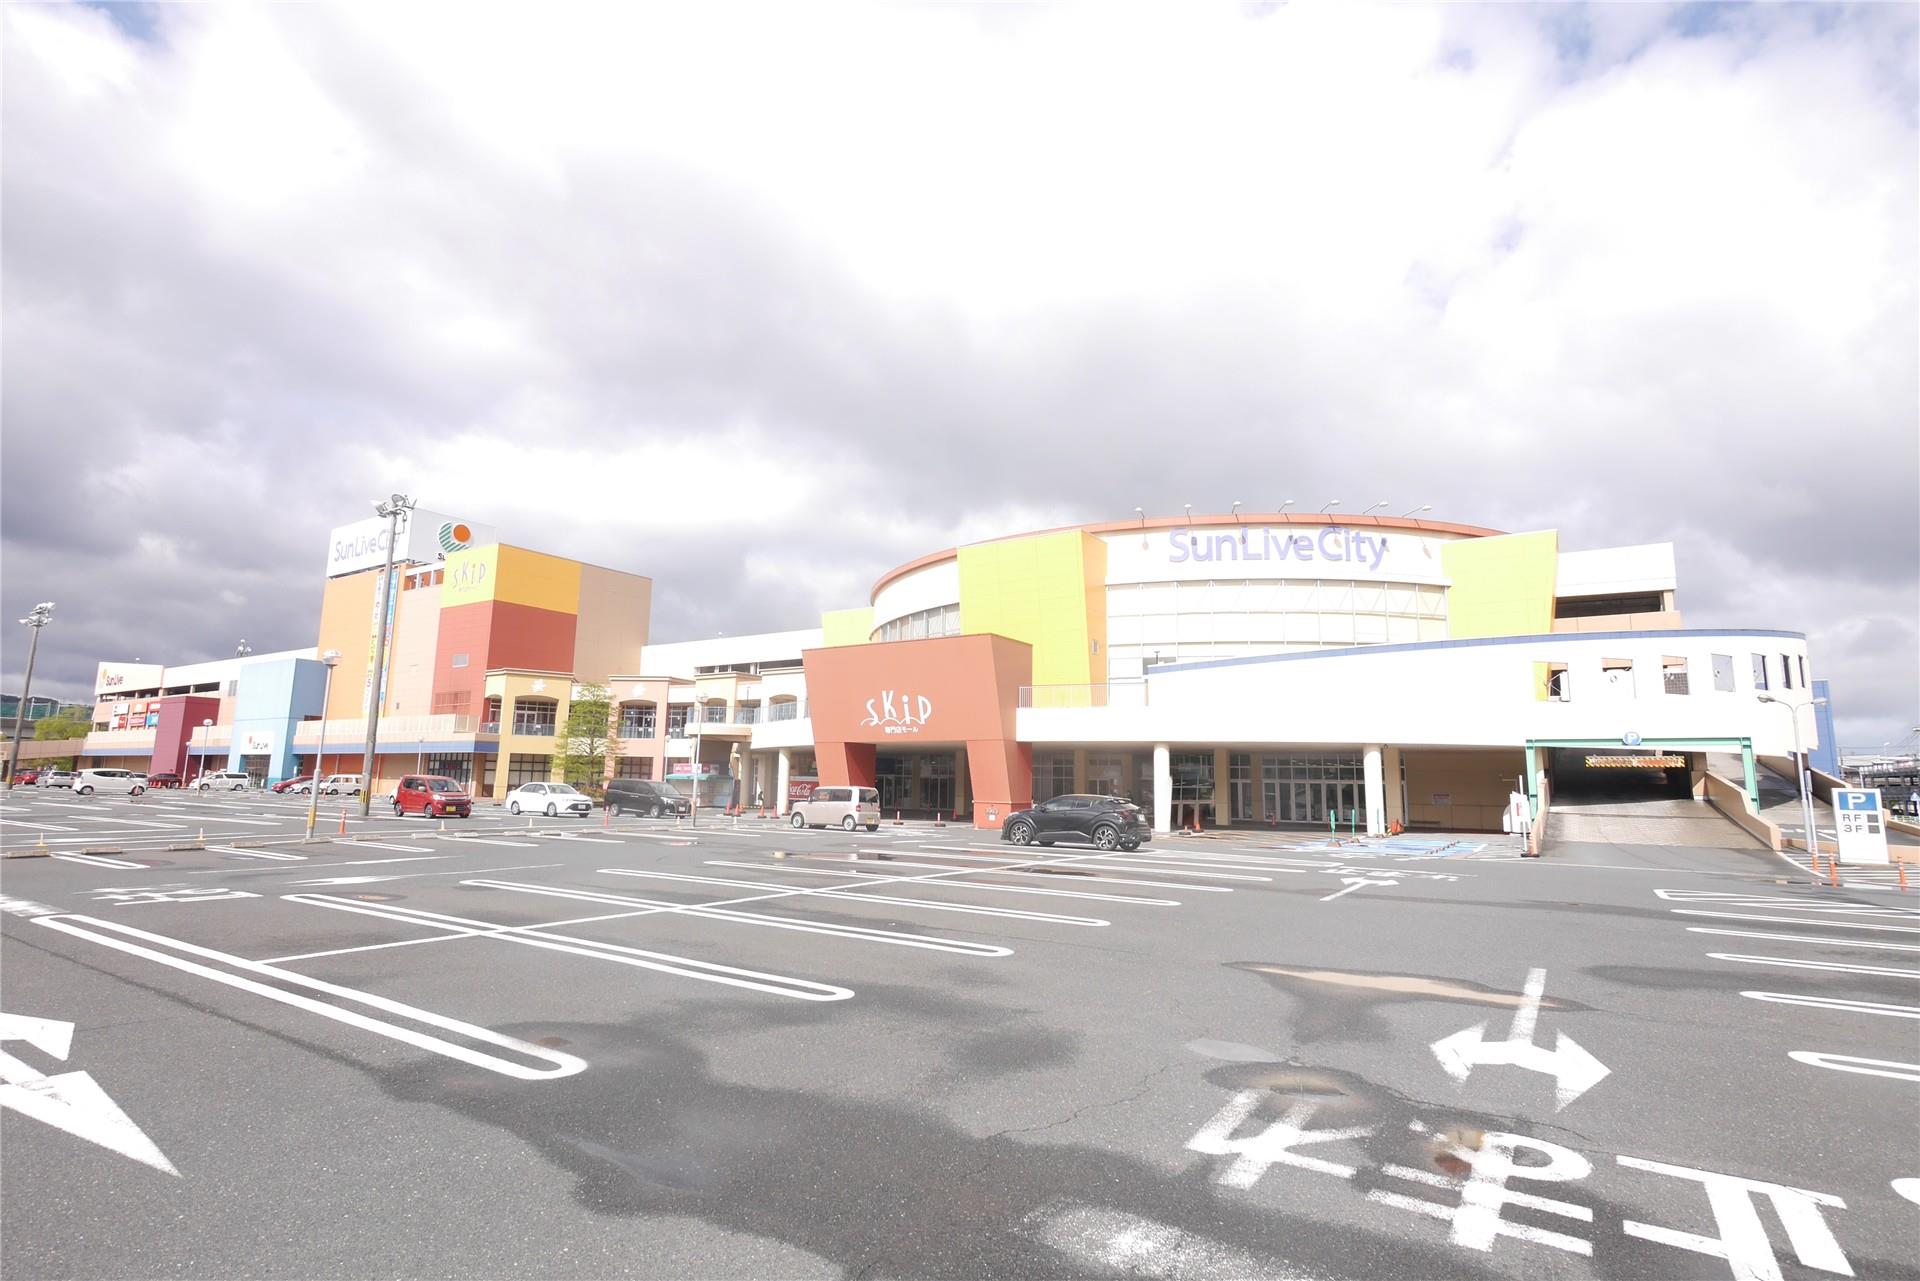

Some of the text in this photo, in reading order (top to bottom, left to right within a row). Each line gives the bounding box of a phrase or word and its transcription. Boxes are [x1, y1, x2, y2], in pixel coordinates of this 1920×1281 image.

[1847, 792, 1866, 809] P
[1842, 813, 1862, 822] RF
[1843, 824, 1863, 833] 3F
